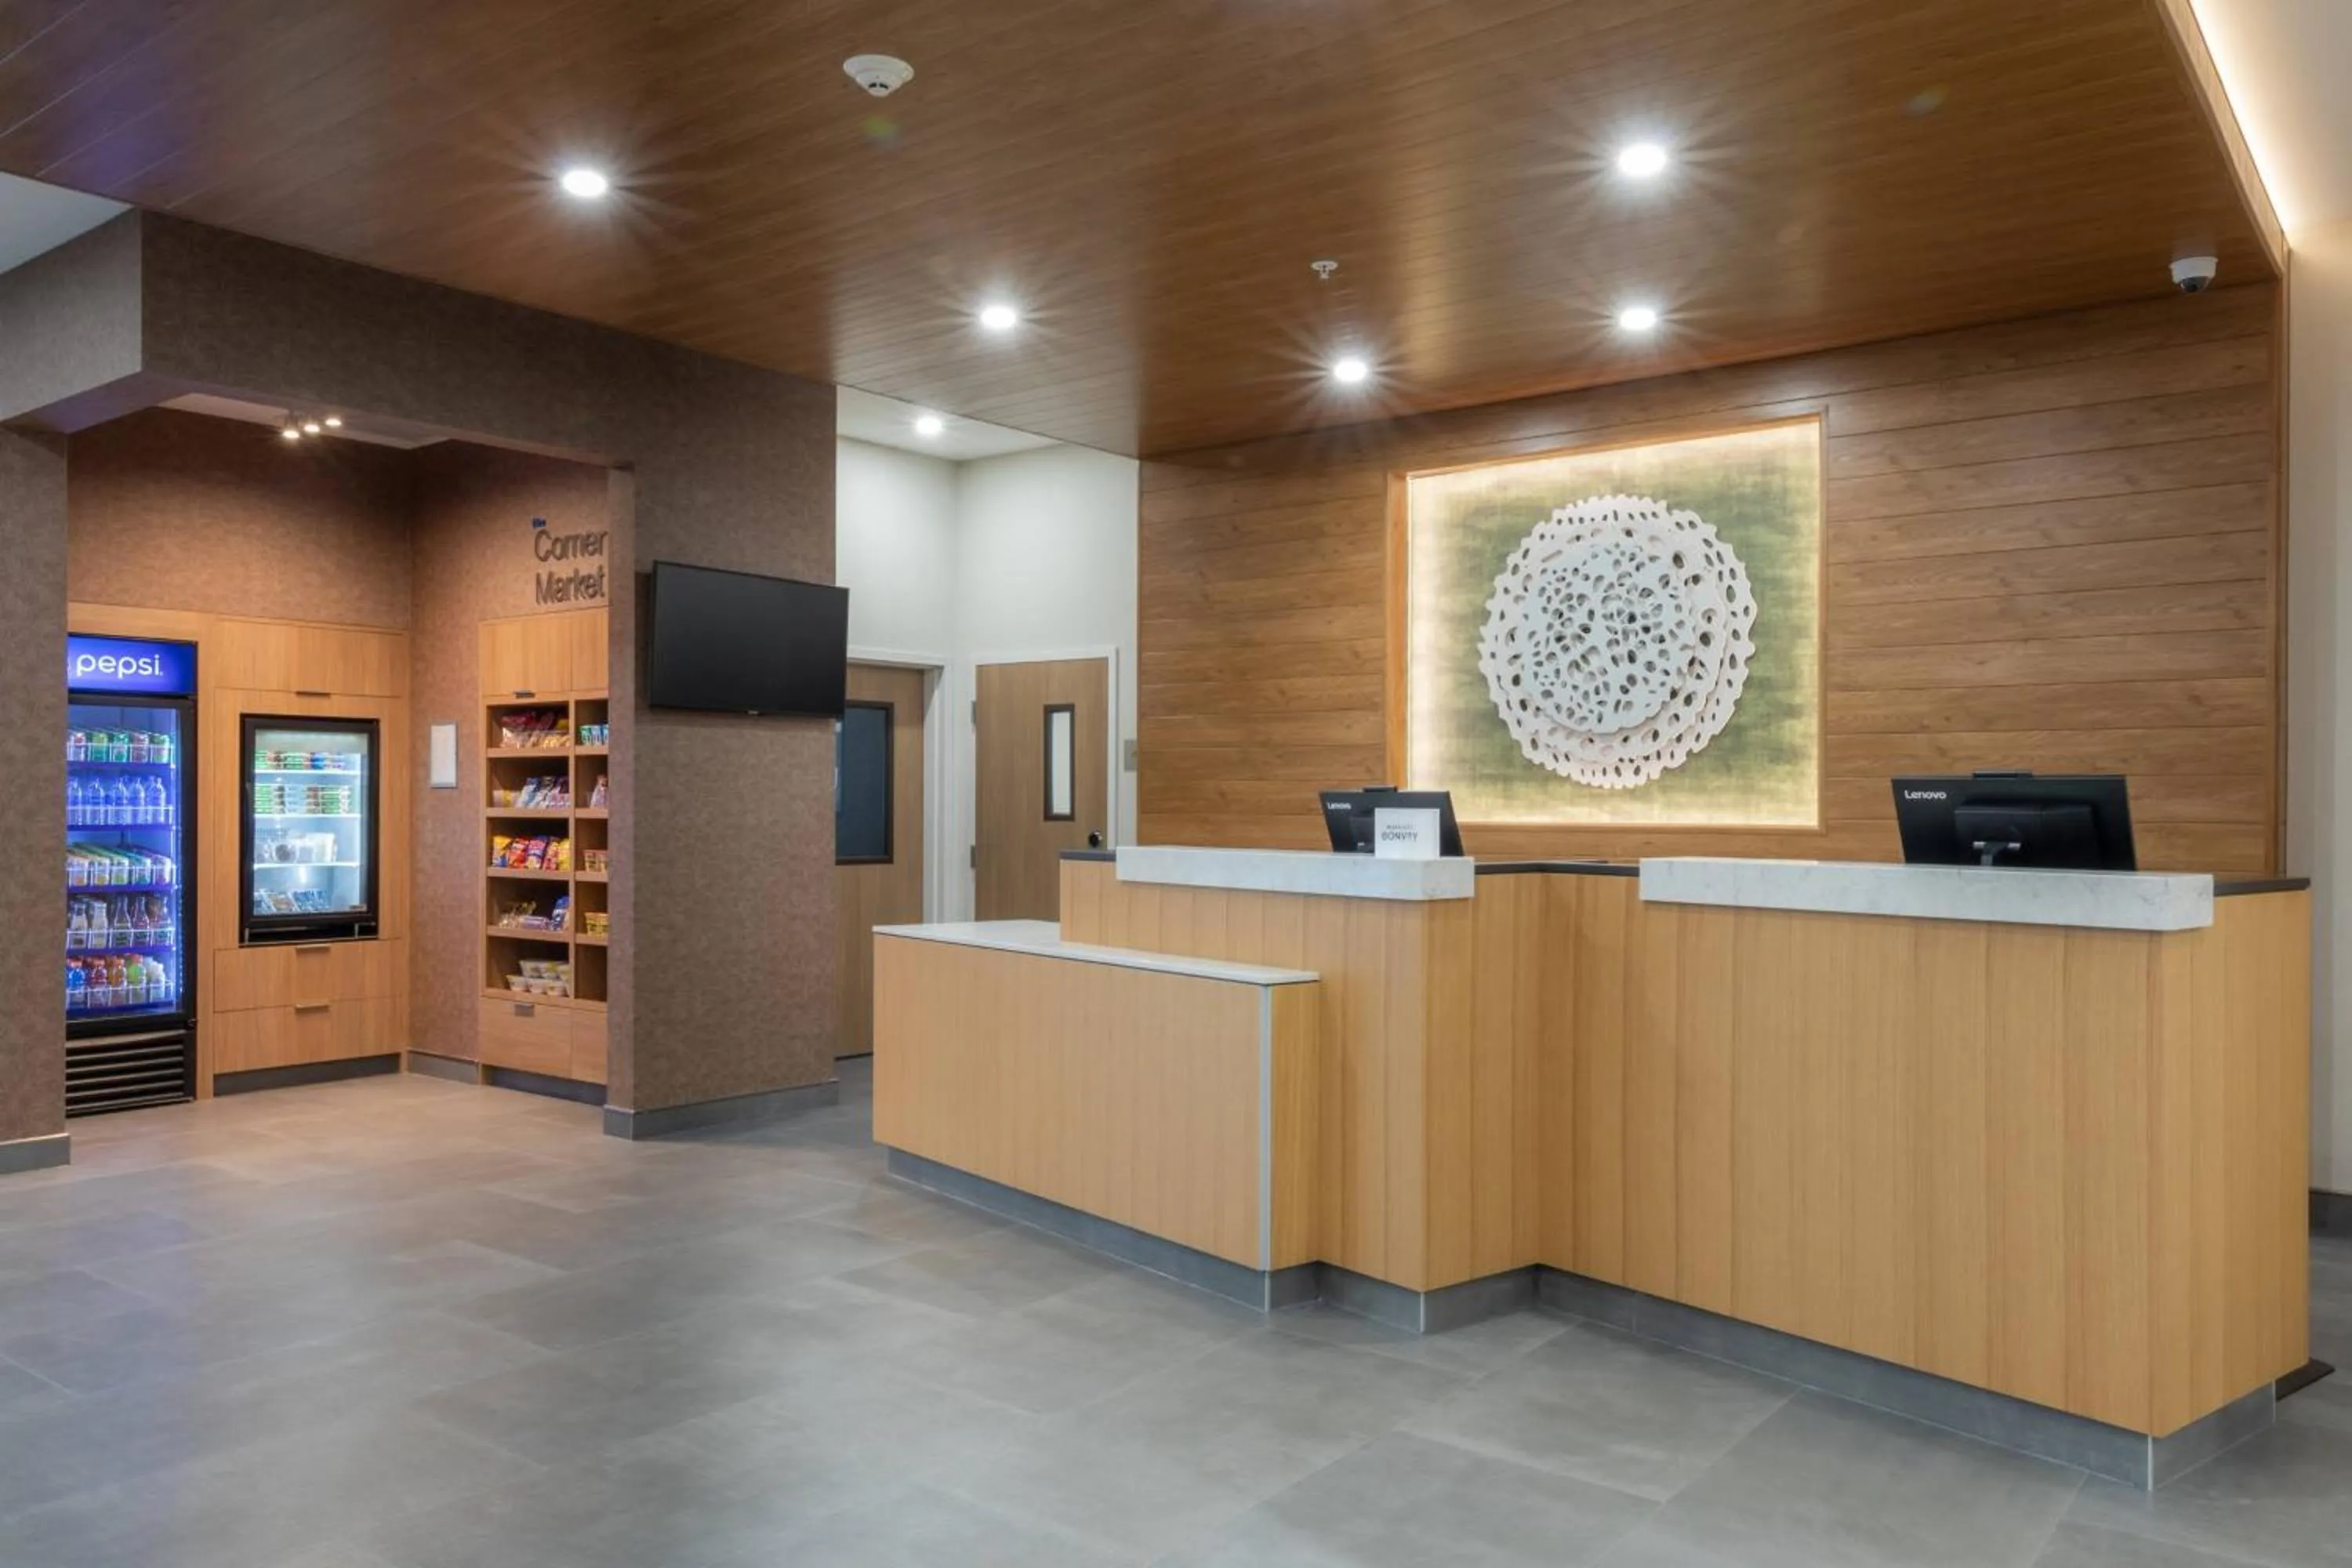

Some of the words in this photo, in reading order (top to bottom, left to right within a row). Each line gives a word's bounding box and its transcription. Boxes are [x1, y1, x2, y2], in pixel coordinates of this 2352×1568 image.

[534, 529, 608, 562] Corner
[535, 564, 606, 606] Market
[76, 653, 161, 679] pepsi
[1904, 789, 1947, 800] Lenovo
